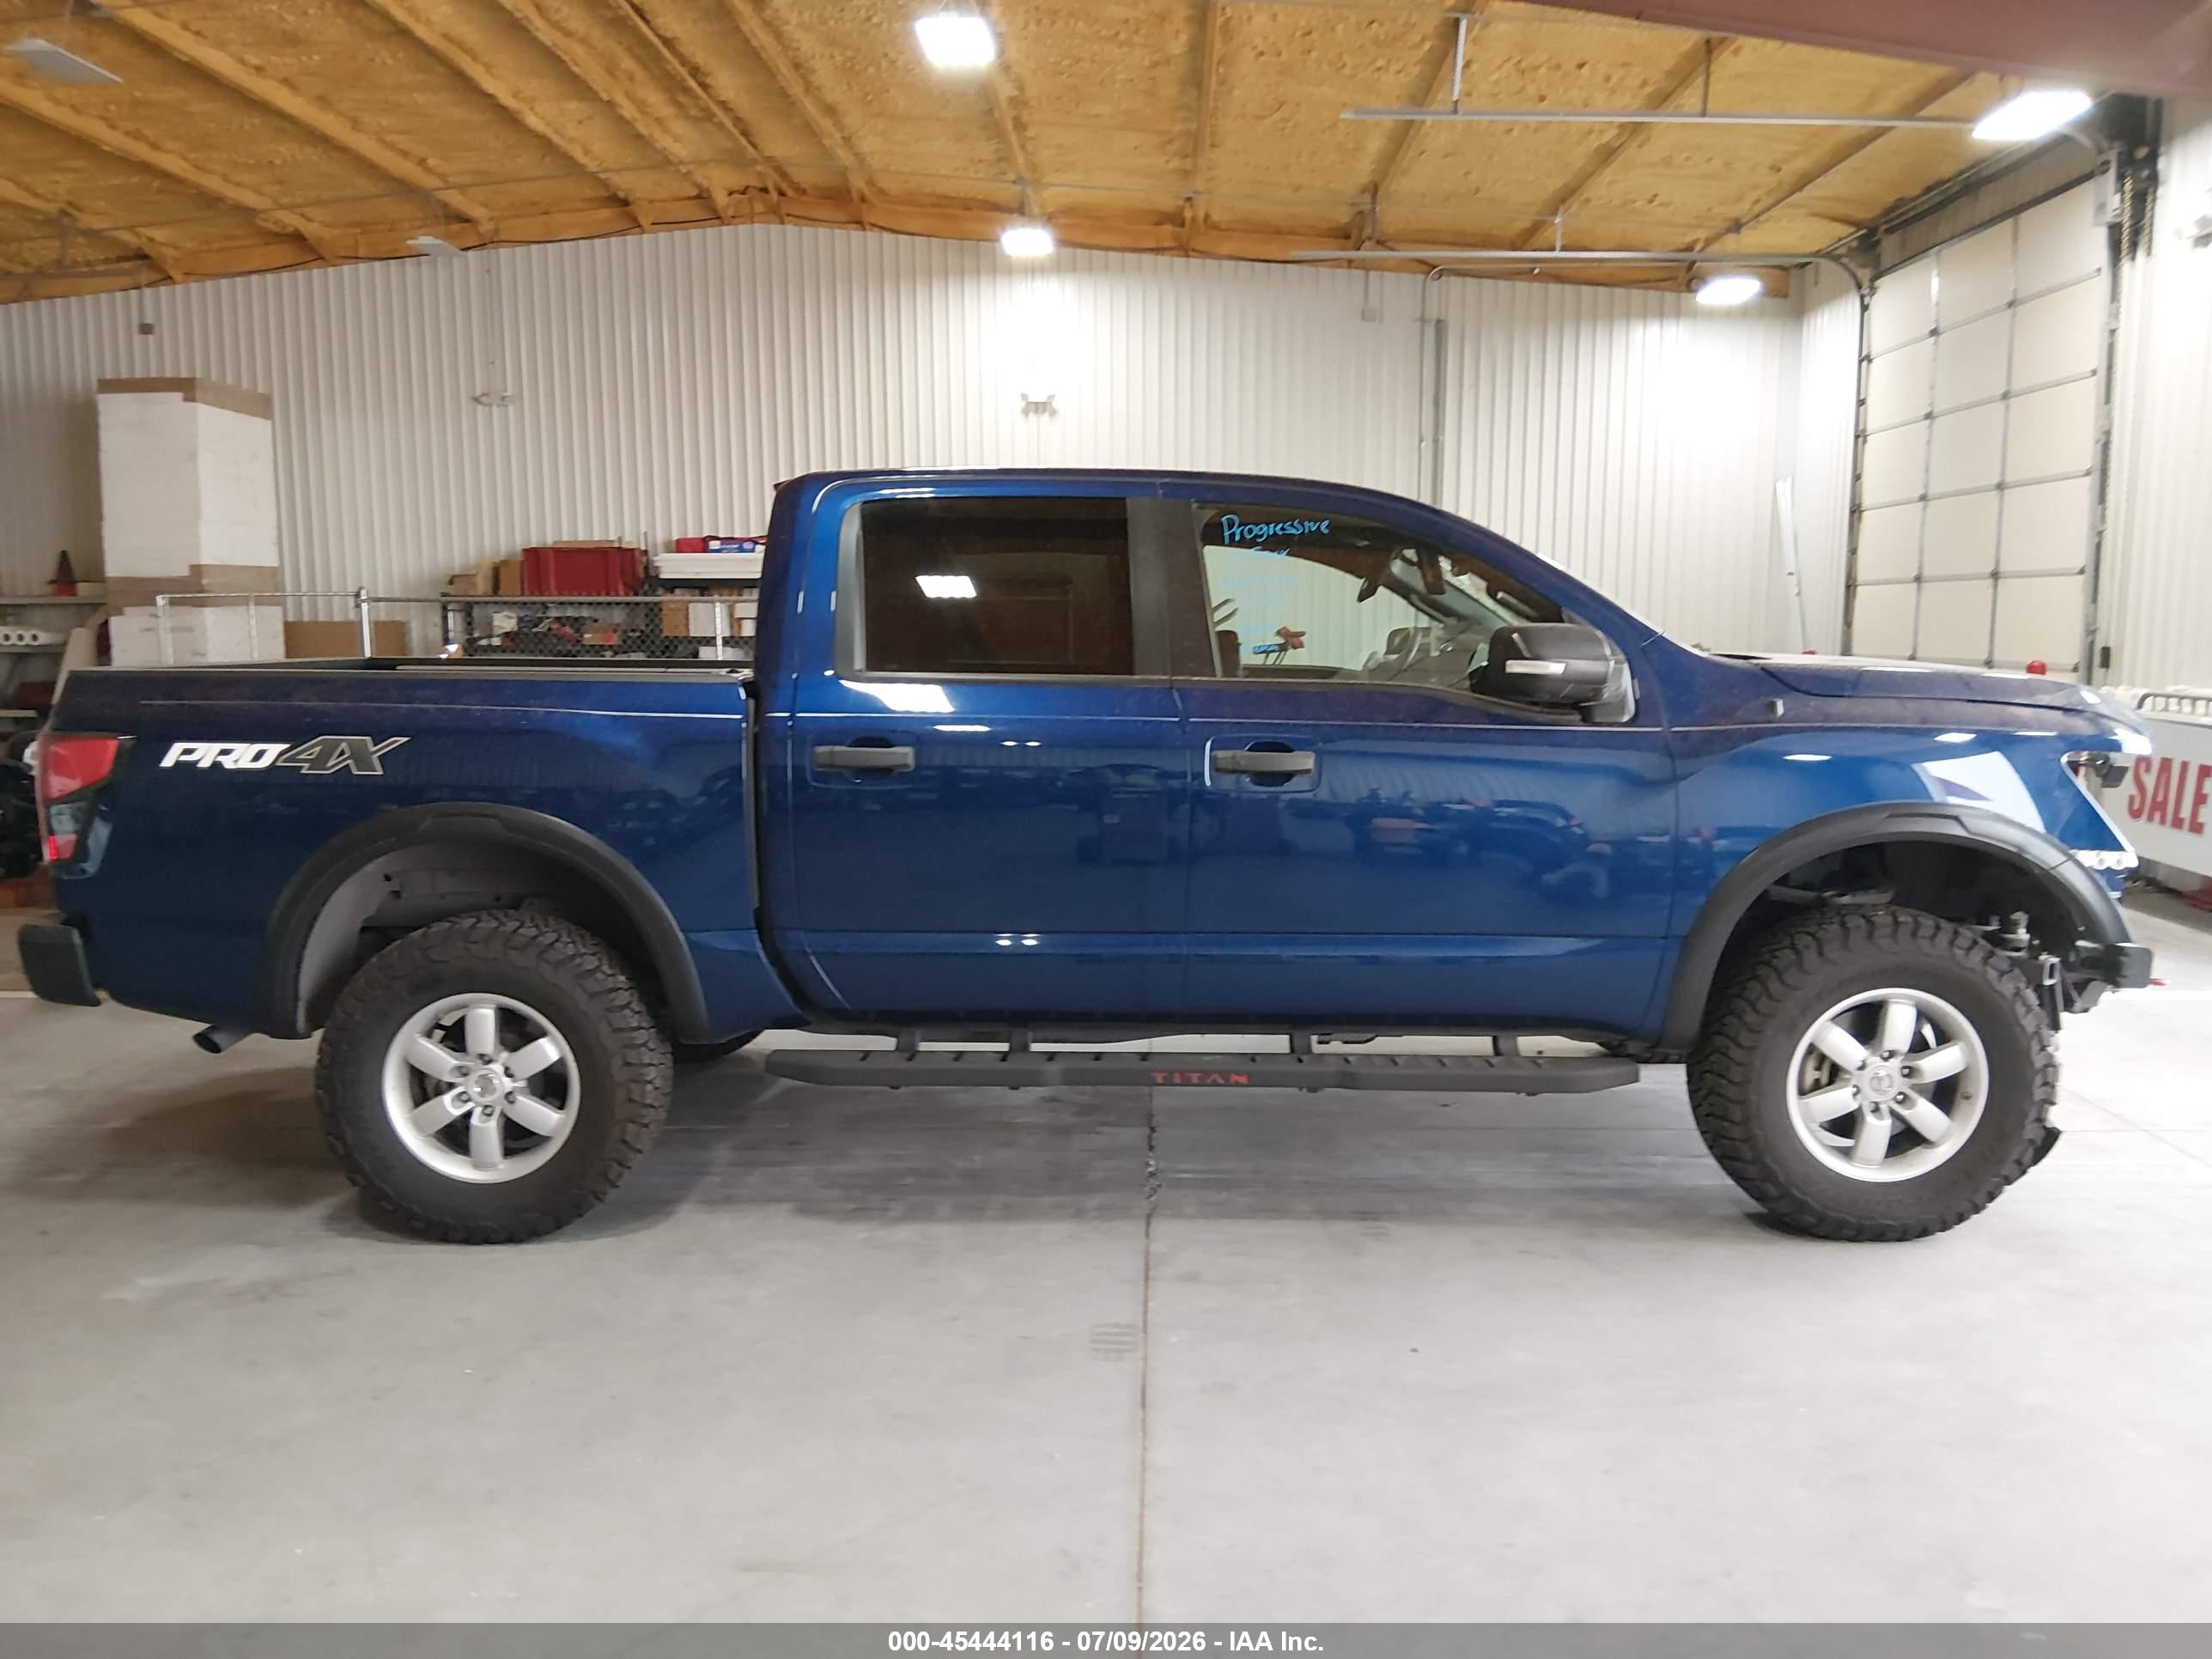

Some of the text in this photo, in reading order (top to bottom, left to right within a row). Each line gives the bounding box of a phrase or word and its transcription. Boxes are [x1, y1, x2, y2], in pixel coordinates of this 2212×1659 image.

[1220, 514, 1330, 544] Progressive
[2128, 756, 2212, 836] SALE
[1151, 1071, 1251, 1085] TITAN
